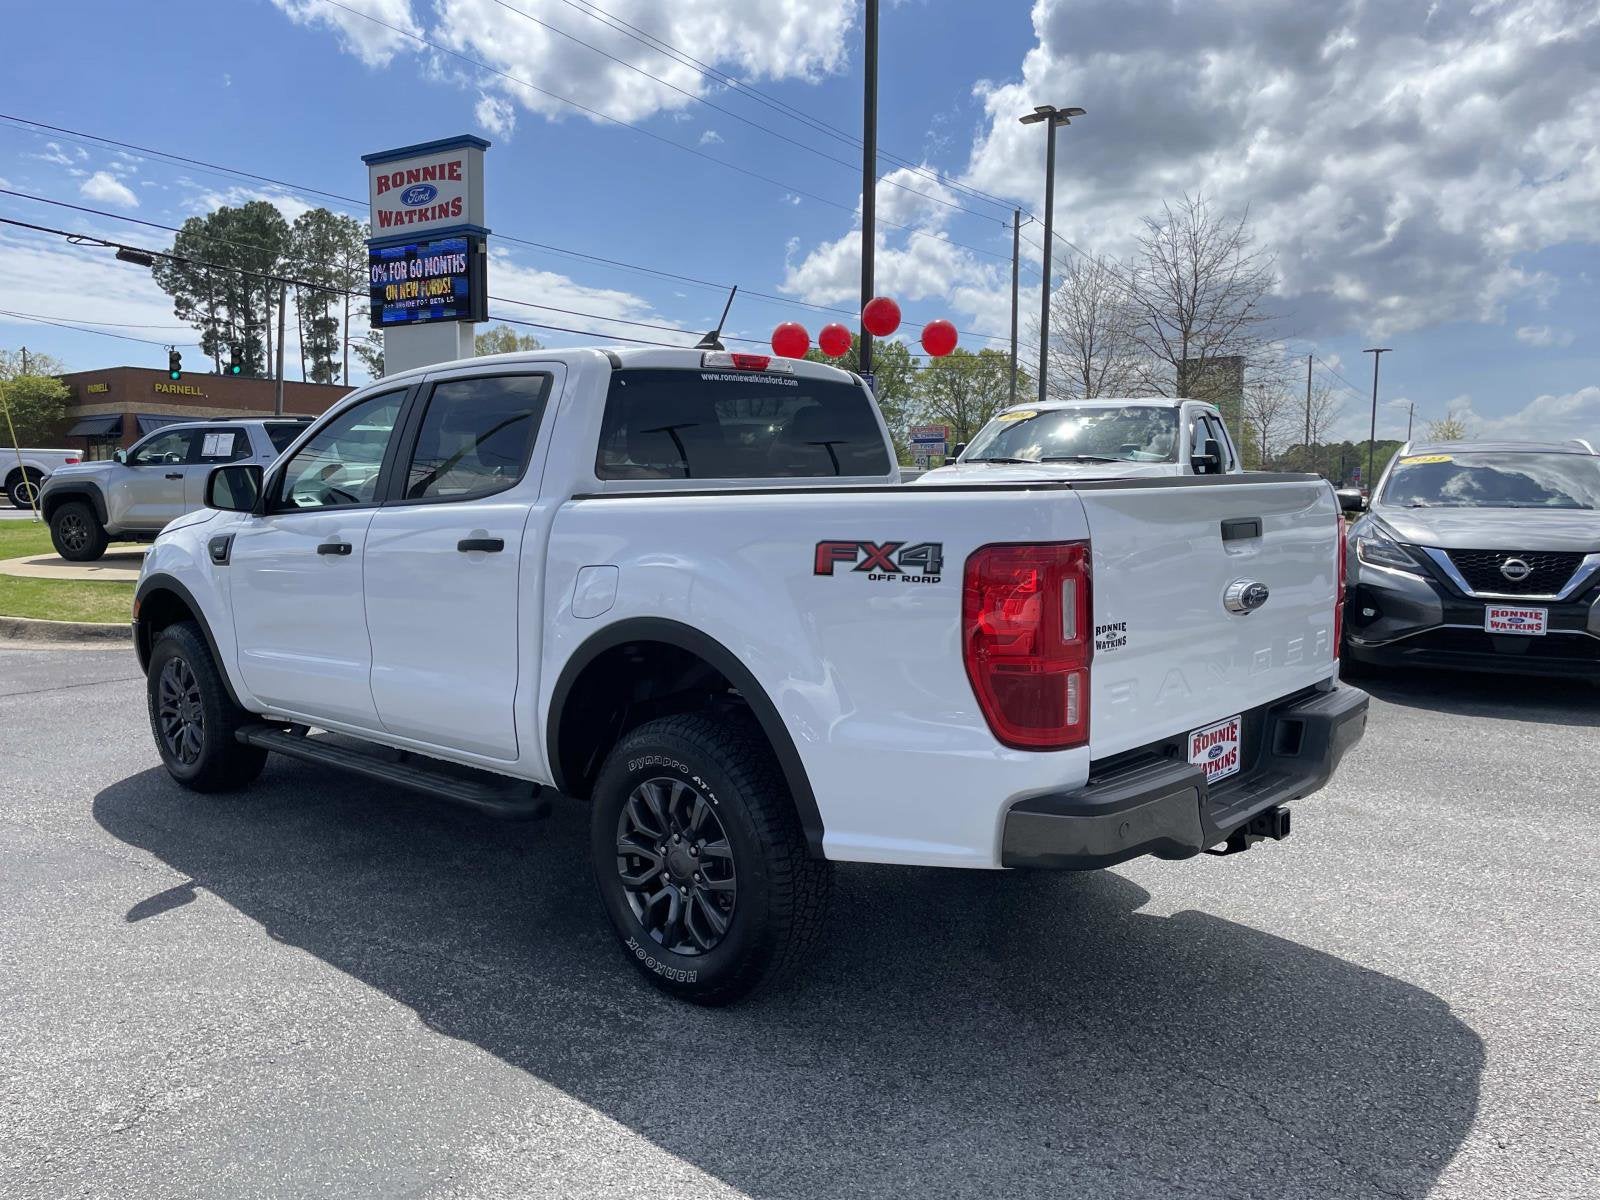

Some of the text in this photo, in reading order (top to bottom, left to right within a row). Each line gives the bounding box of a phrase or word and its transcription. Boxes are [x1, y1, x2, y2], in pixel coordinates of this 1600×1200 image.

[377, 161, 461, 195] RONNIE
[378, 197, 462, 228] WATKINS
[371, 253, 466, 283] 0% FOR 60 MONTHS
[385, 277, 451, 300] ON NEW FORDS!
[701, 373, 798, 386] www.ronniewatkinsford.com
[155, 383, 203, 396] PARNELL
[813, 540, 944, 576] FX4
[867, 573, 942, 584] OFF ROAD
[1490, 609, 1542, 620] RONNIE
[1096, 622, 1126, 636] RONNIE
[1490, 621, 1542, 631] WATKINS
[1096, 635, 1127, 650] WATKINS
[1193, 724, 1237, 758] RONNIE
[628, 755, 689, 772] Dynapro
